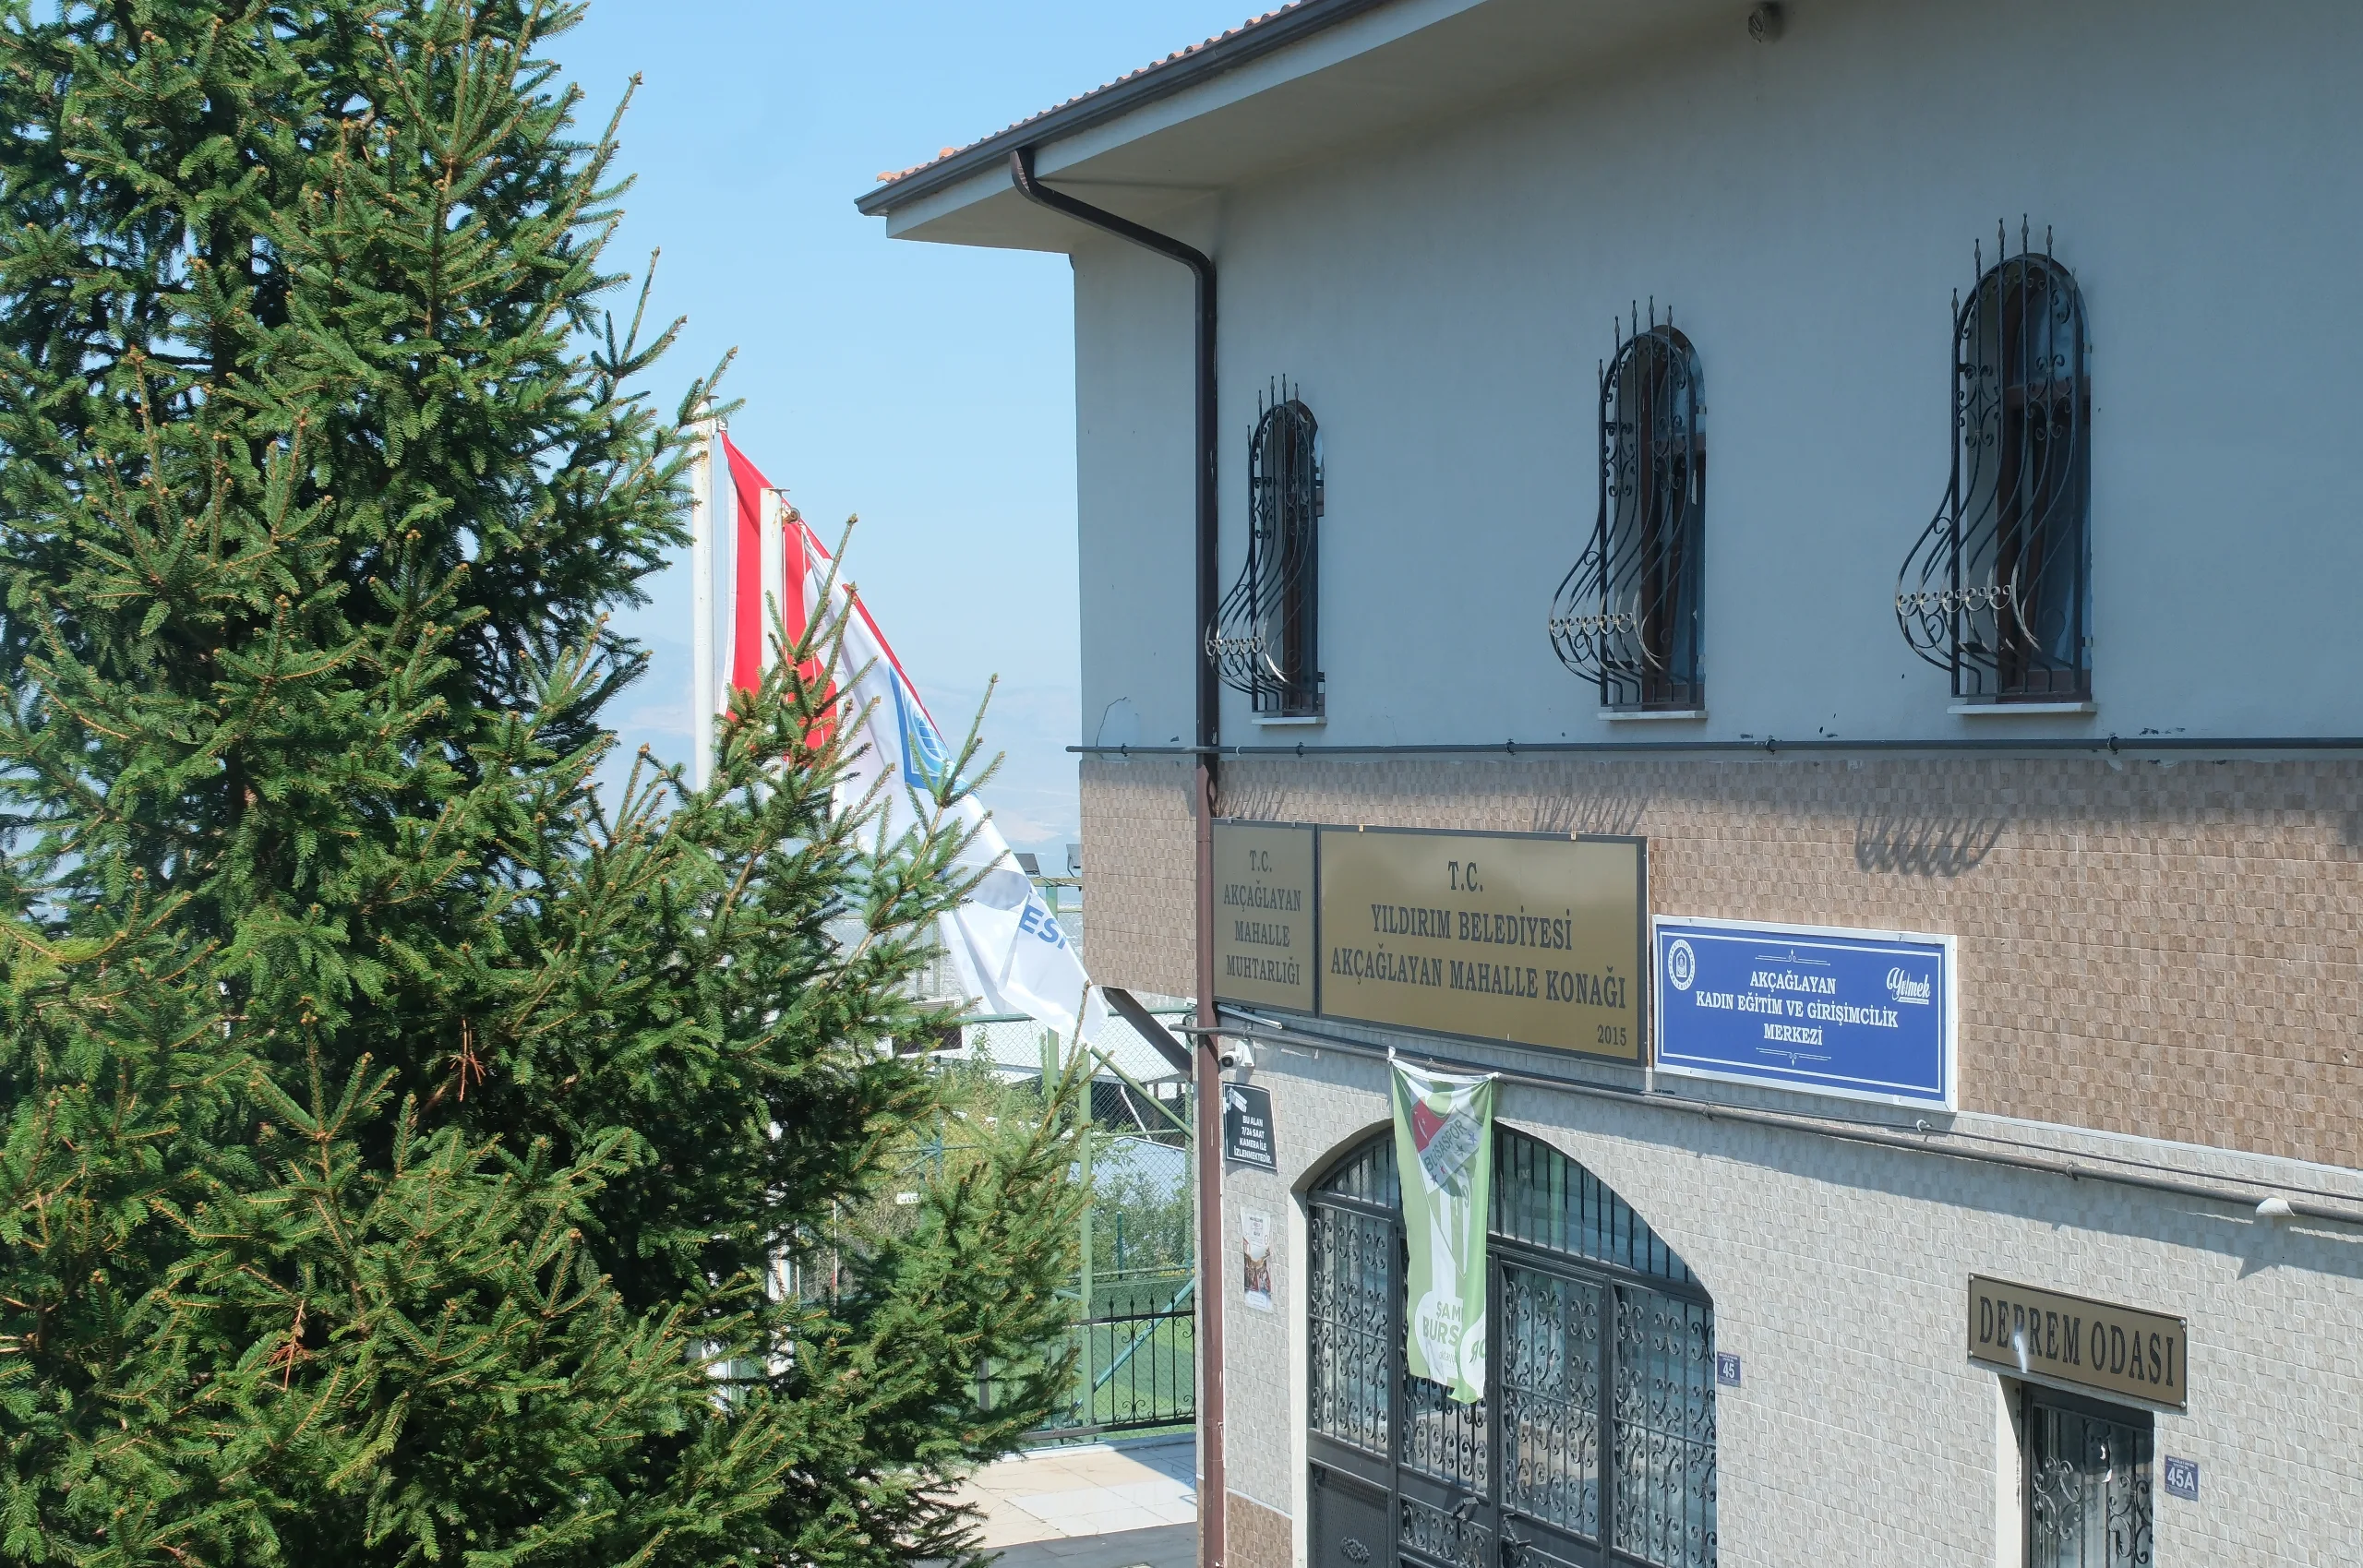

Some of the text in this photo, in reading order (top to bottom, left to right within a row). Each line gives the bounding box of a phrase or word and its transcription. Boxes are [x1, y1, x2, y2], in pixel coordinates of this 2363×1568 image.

[1249, 850, 1272, 872] T.C.
[1447, 861, 1483, 892] T.C.
[1223, 880, 1301, 912] AKÇAĞLAYAN
[1235, 920, 1290, 948] MAHALLE
[1371, 904, 1572, 951] YILDIRIM BELEDİYESİ
[1226, 954, 1301, 986] MUHTARLIĞI
[1330, 942, 1625, 1010] AKÇAĞLAYAN MAHALLE KONAĞI
[1750, 969, 1836, 995] AKÇAĞLAYAN
[1696, 990, 1898, 1028] KADIN EĞİTİM VE GİRİŞİMCİLİK
[1597, 1023, 1627, 1047] 2015
[1764, 1023, 1823, 1046] MERKEZİ
[1251, 1117, 1264, 1128] ALAN
[1253, 1128, 1265, 1139] SAAT
[1239, 1137, 1260, 1150] KAMERA
[1435, 1300, 1464, 1323] ŞAM
[1979, 1296, 2174, 1387] DEPREM ODASI
[1722, 1361, 1735, 1379] 45
[2167, 1466, 2195, 1491] 45A
